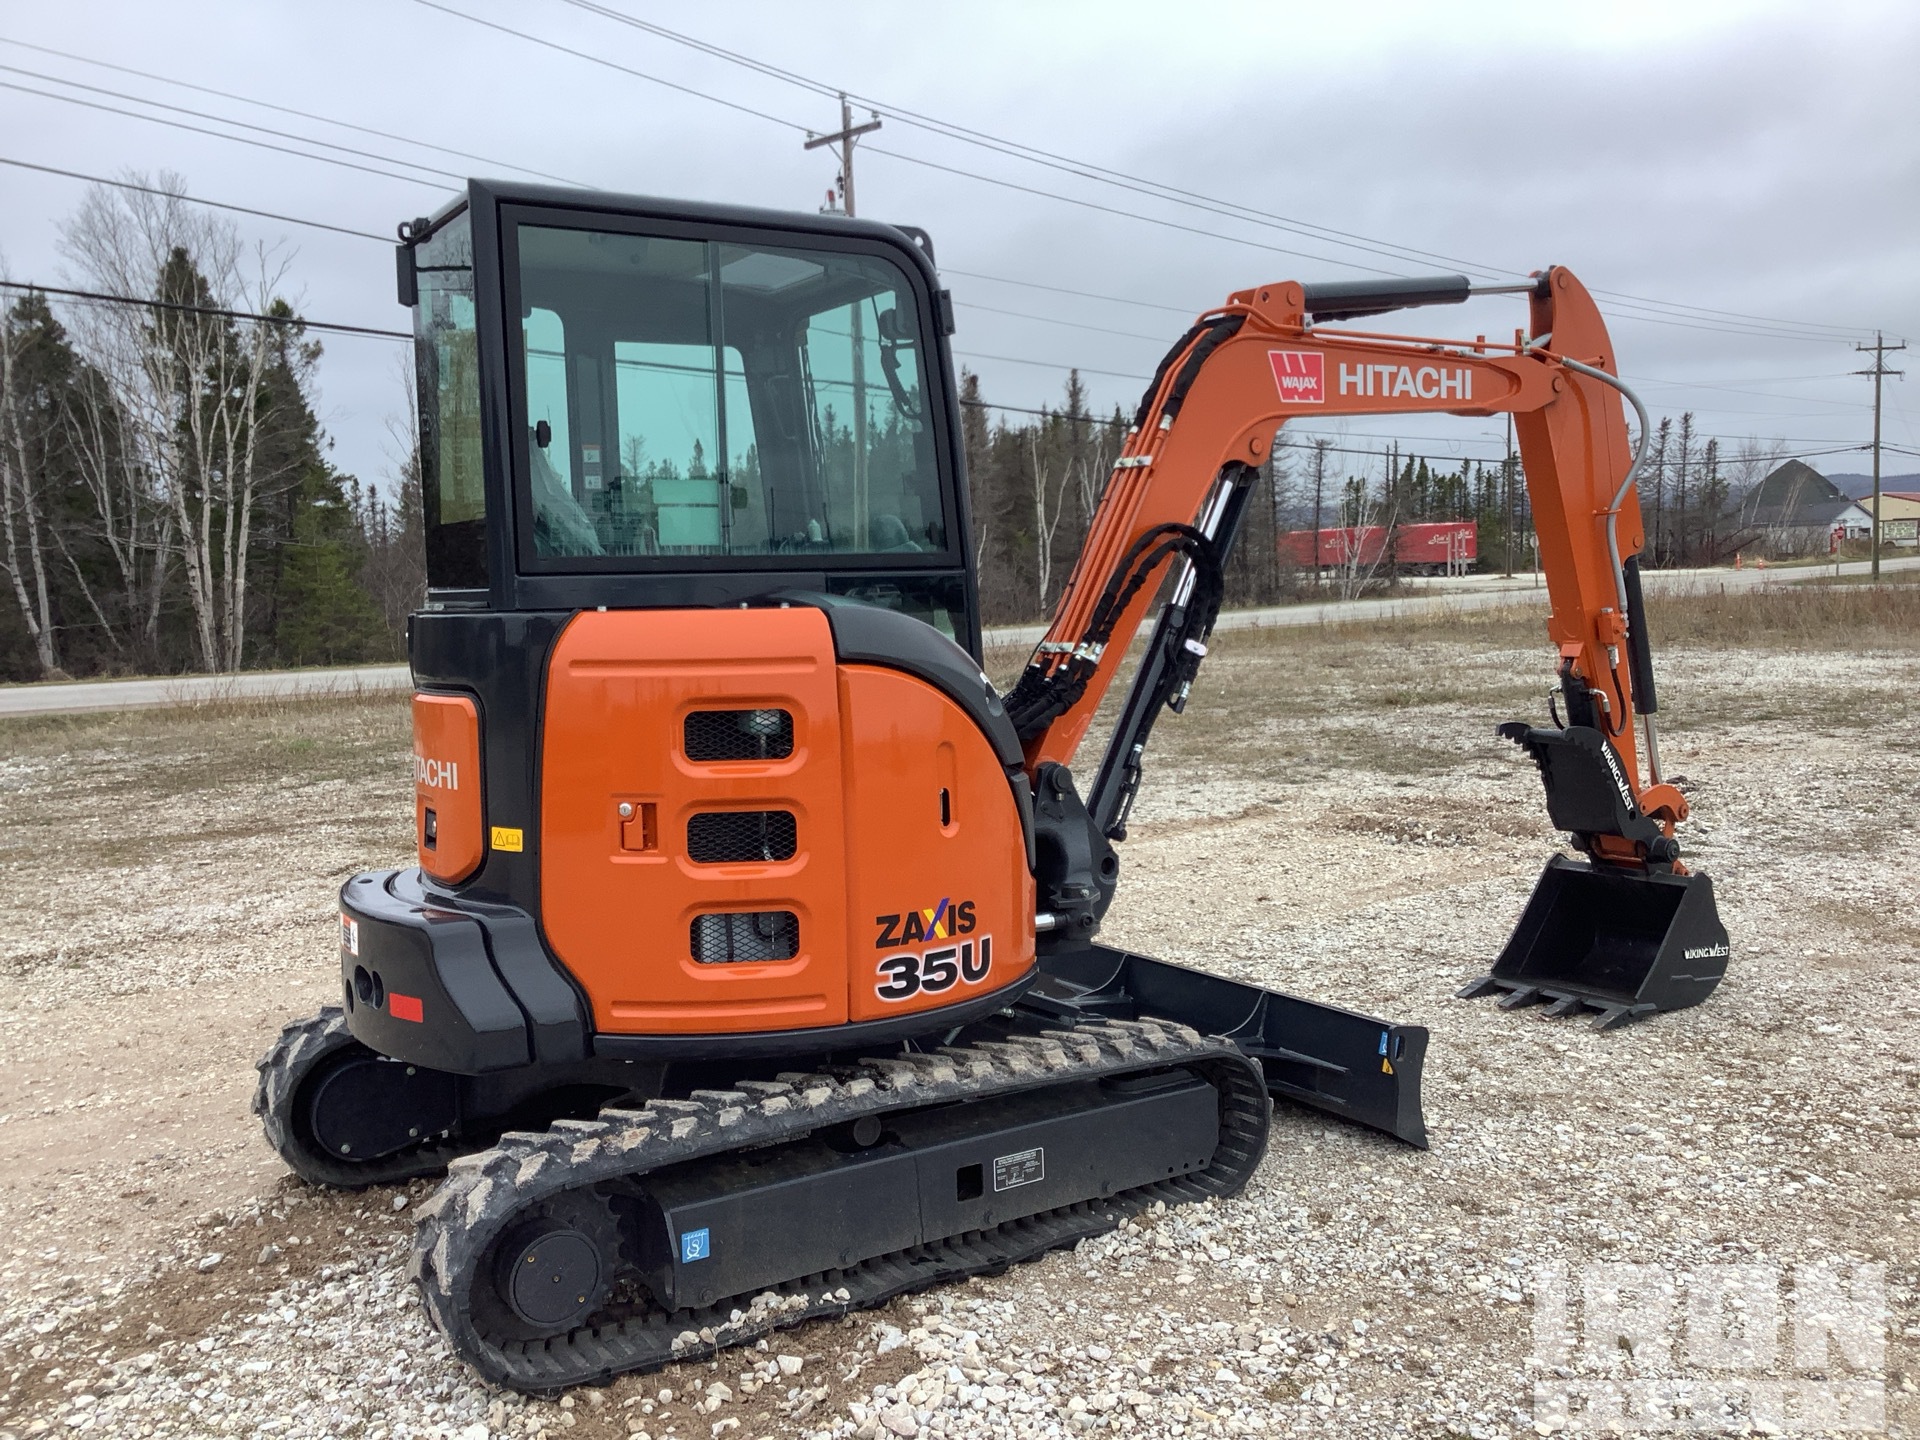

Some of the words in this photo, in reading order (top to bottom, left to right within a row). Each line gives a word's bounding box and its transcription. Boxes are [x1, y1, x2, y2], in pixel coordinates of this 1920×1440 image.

[1281, 376, 1318, 392] WAJAX
[1339, 362, 1472, 400] HITACHI
[414, 754, 458, 790] TACHI
[875, 897, 977, 949] ZAXIS
[874, 933, 993, 1003] 35U
